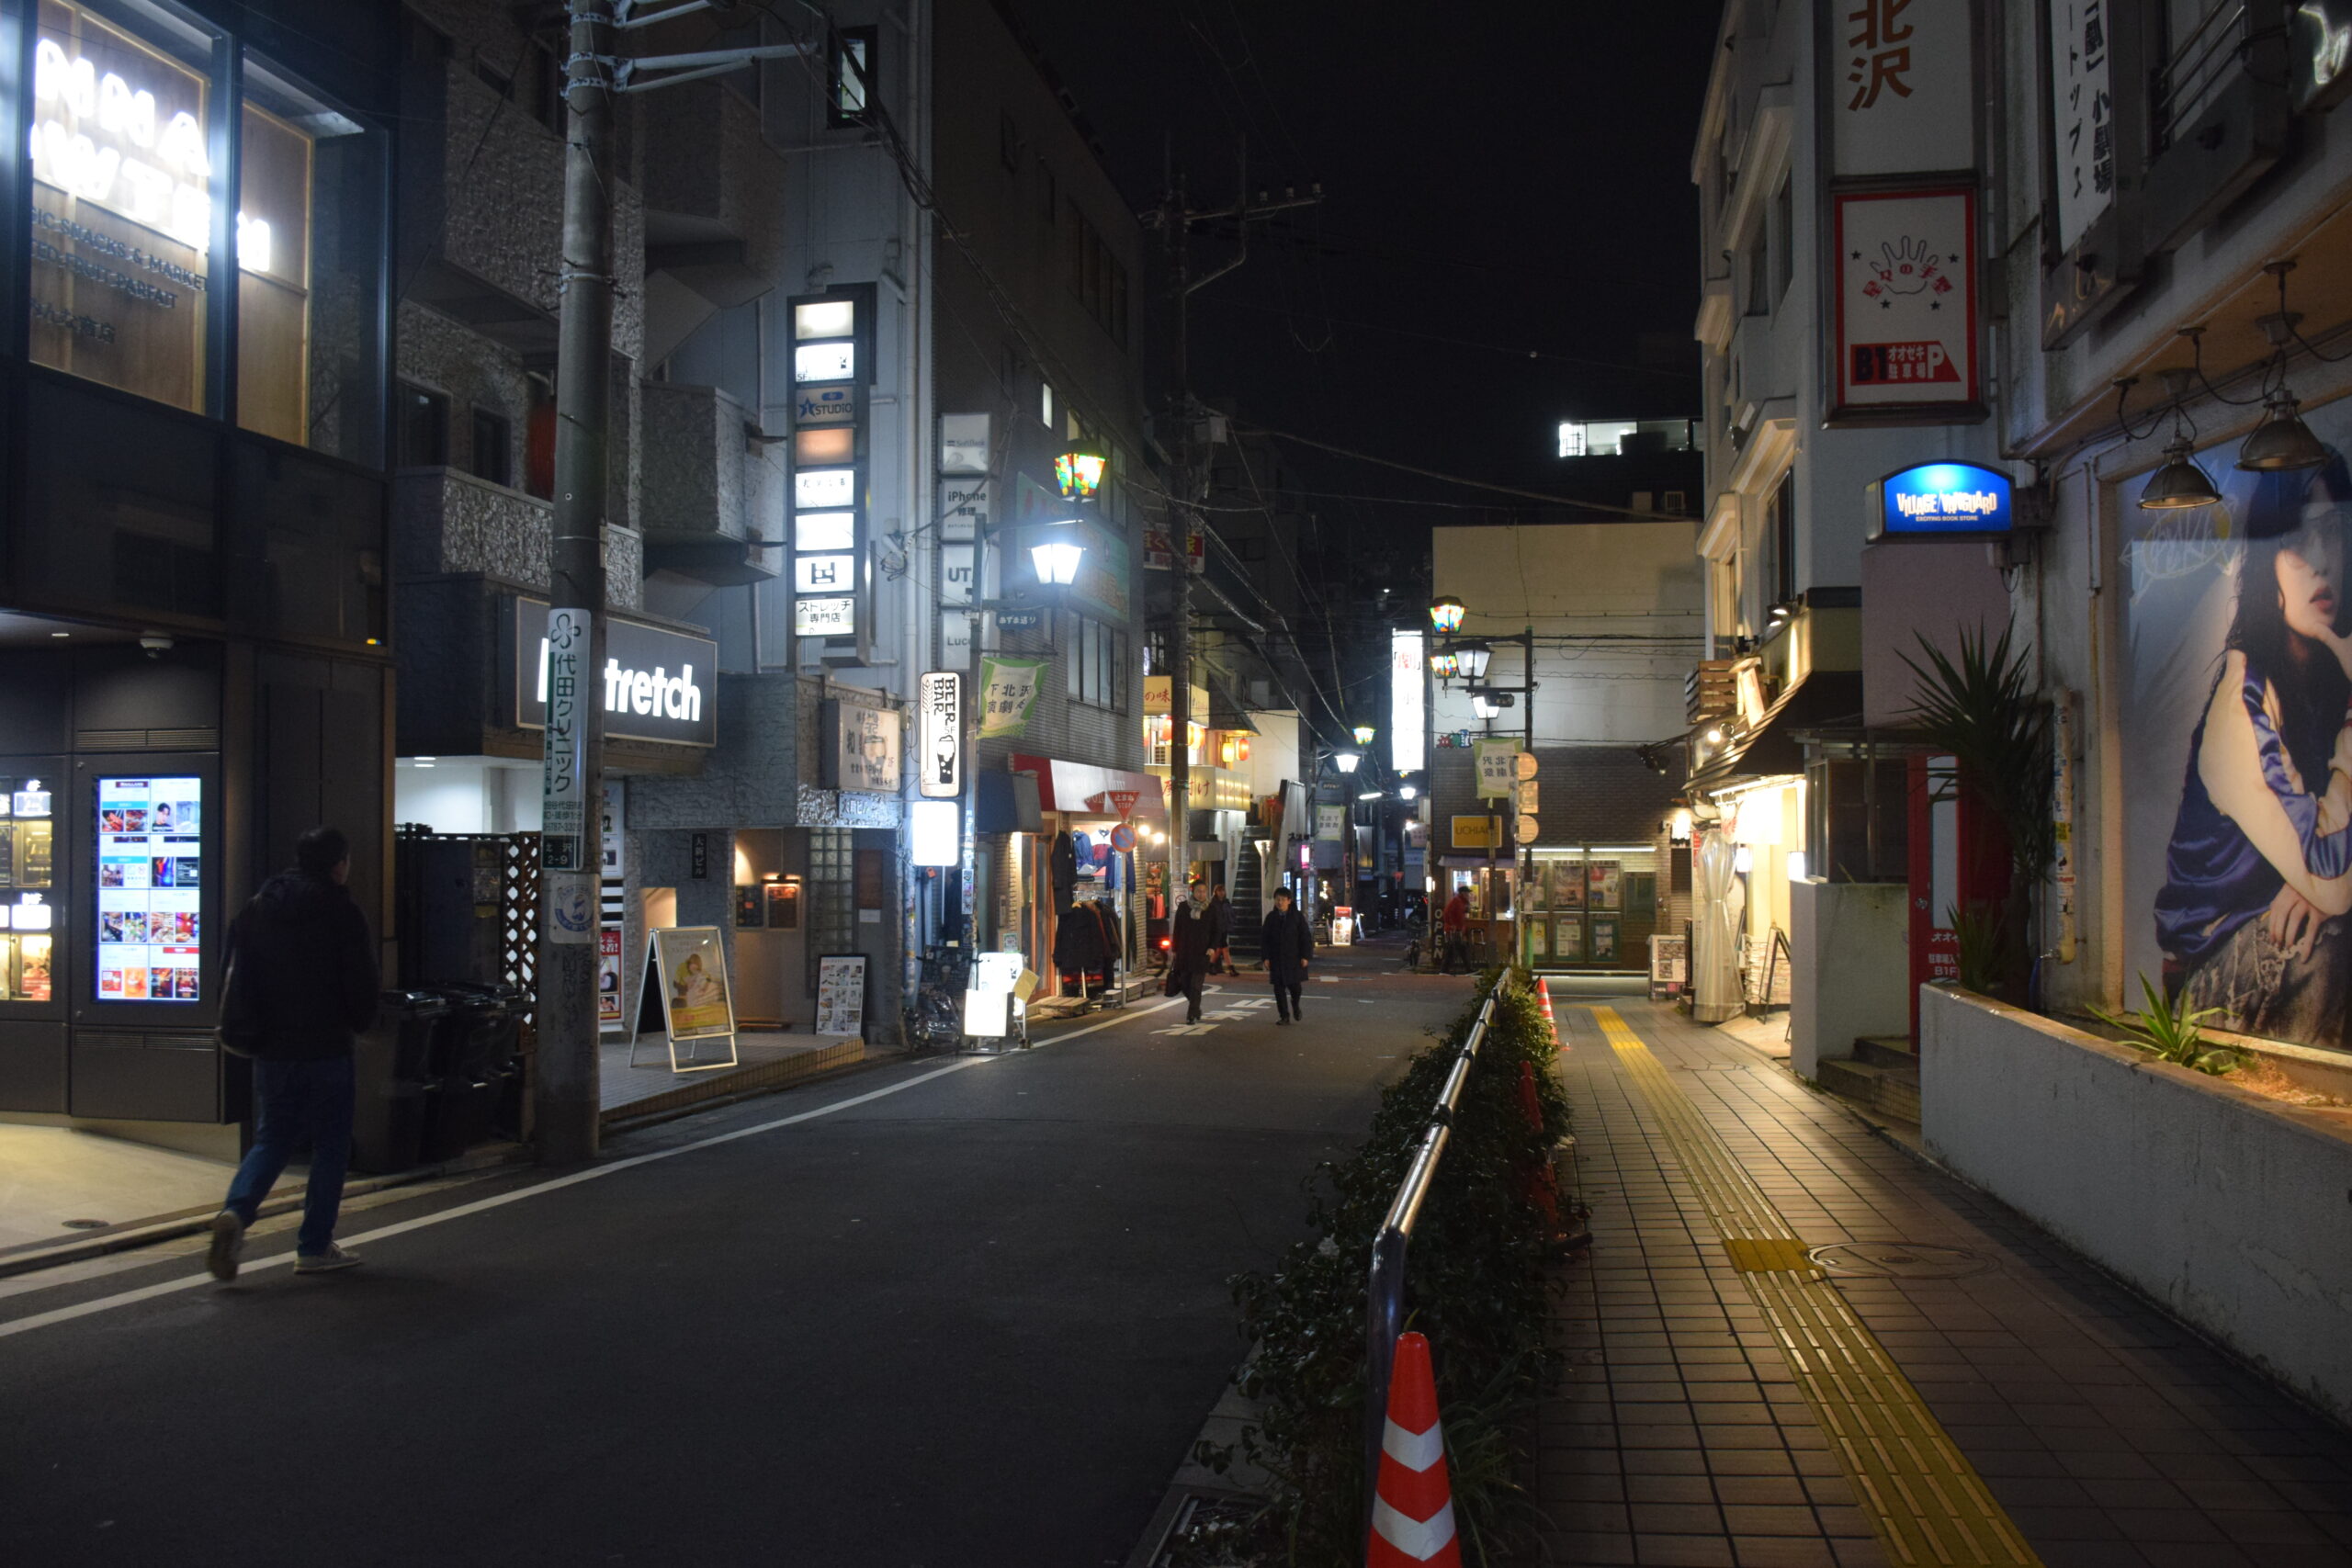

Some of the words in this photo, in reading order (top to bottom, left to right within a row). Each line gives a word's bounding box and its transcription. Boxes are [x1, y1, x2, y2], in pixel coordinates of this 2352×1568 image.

[1847, 0, 1915, 111] 北沢
[1888, 344, 1925, 361] オオゼキ
[1856, 347, 1886, 380] B1
[1927, 344, 1945, 378] P
[948, 491, 987, 502] iPhone
[948, 567, 974, 582] UT
[798, 600, 851, 613] ストレッチ
[809, 613, 841, 623] 専門店
[947, 637, 970, 646] Luc
[933, 678, 944, 716] BAR
[944, 677, 956, 726] BEER
[554, 653, 576, 792] 代田クリニック
[548, 854, 569, 865] 2-9
[1928, 953, 1956, 964] 駐車場入
[1934, 965, 1957, 976] B1F
